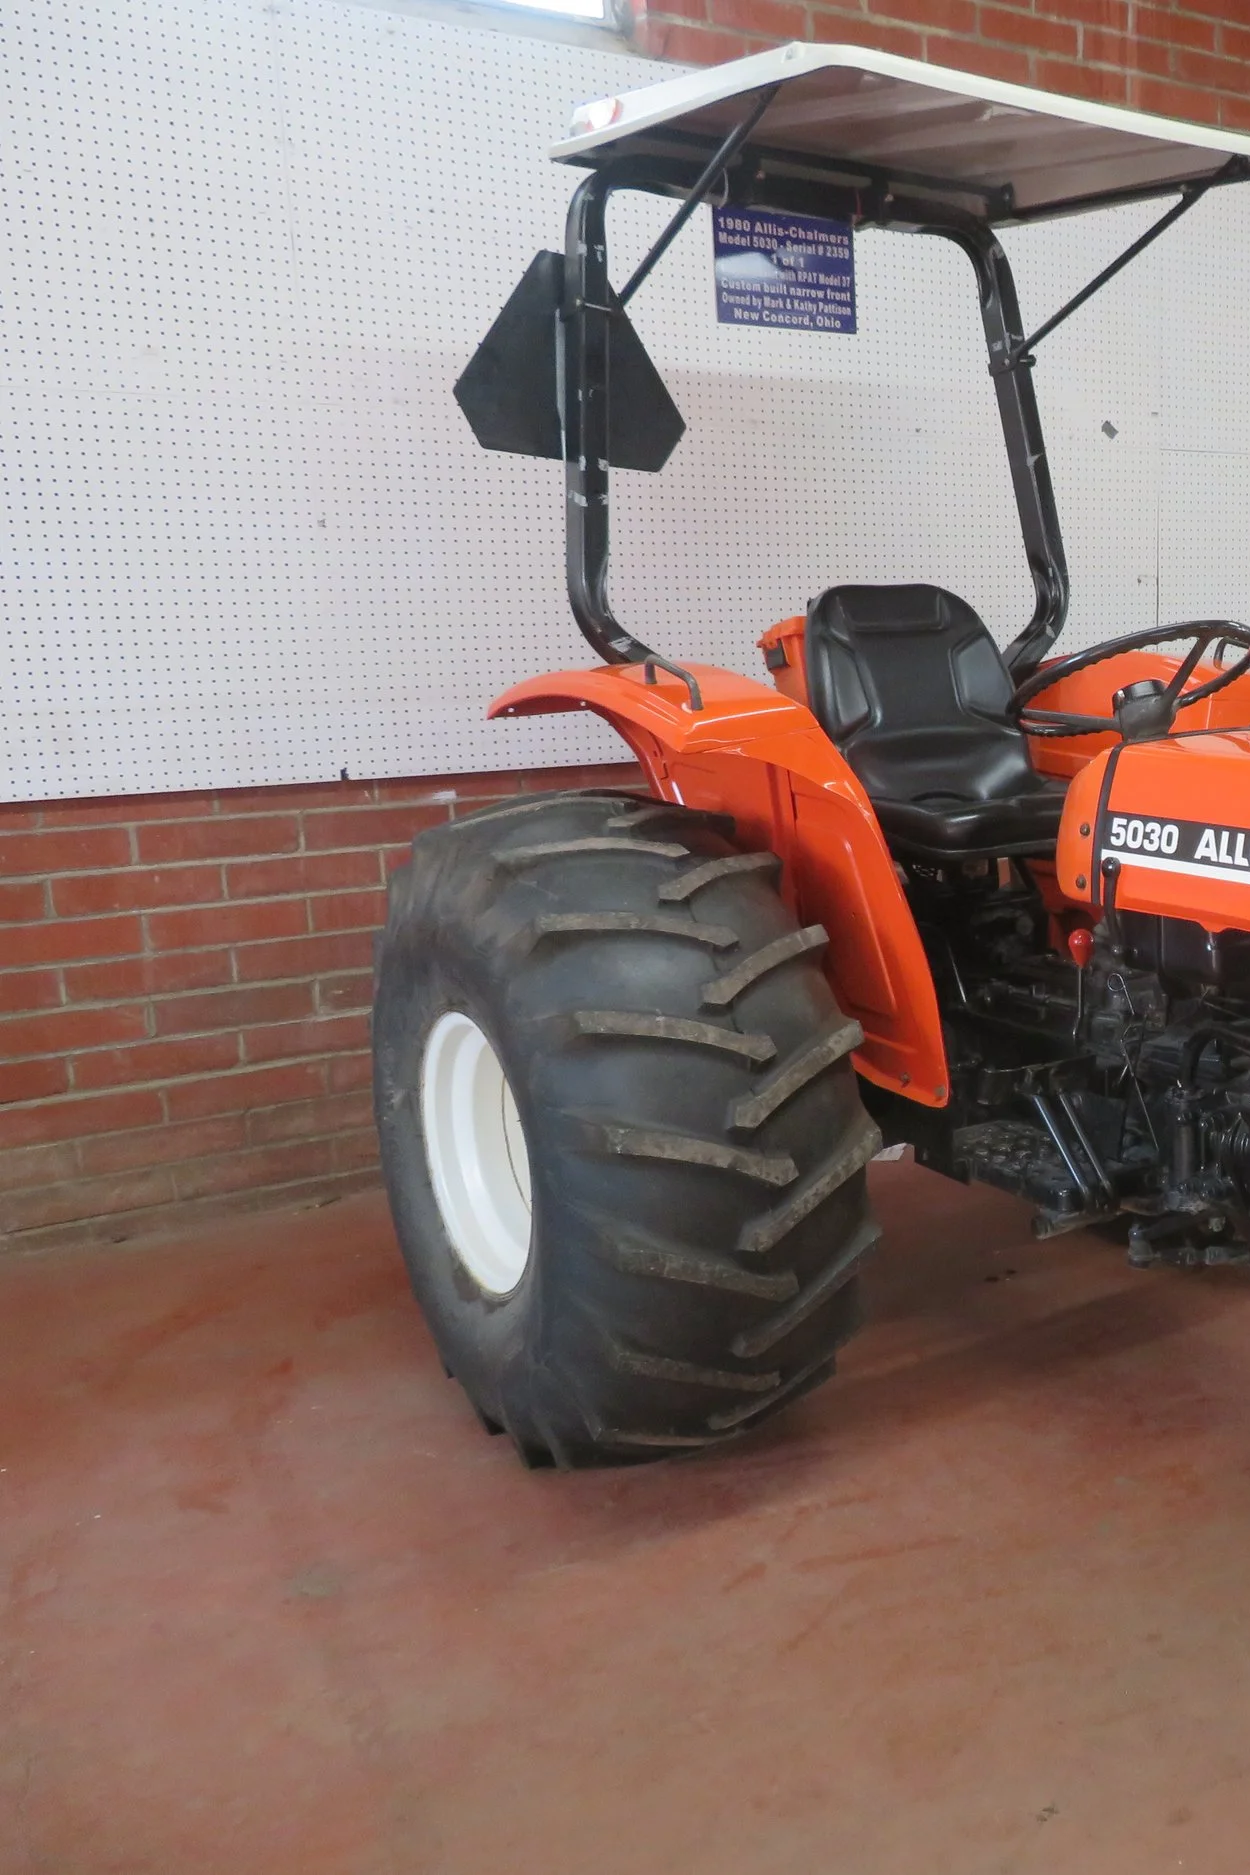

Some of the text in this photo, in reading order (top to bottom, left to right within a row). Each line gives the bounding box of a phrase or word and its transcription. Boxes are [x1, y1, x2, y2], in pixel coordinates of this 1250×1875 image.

[718, 217, 849, 245] 1980 Allis-Chalmers
[718, 232, 751, 247] Model
[753, 235, 778, 250] 5030
[786, 241, 816, 254] Serial
[826, 246, 850, 260] 2359
[782, 255, 795, 267] of
[721, 278, 851, 302] Custom built narrow front
[818, 273, 841, 287] Model
[842, 277, 850, 288] 37
[722, 292, 750, 306] Owned
[753, 296, 761, 309] by
[764, 297, 784, 309] Mark
[794, 299, 817, 314] Kathy
[819, 302, 851, 316] Pattison
[733, 308, 841, 329] New Concord, Ohio
[1110, 817, 1179, 854] 5030
